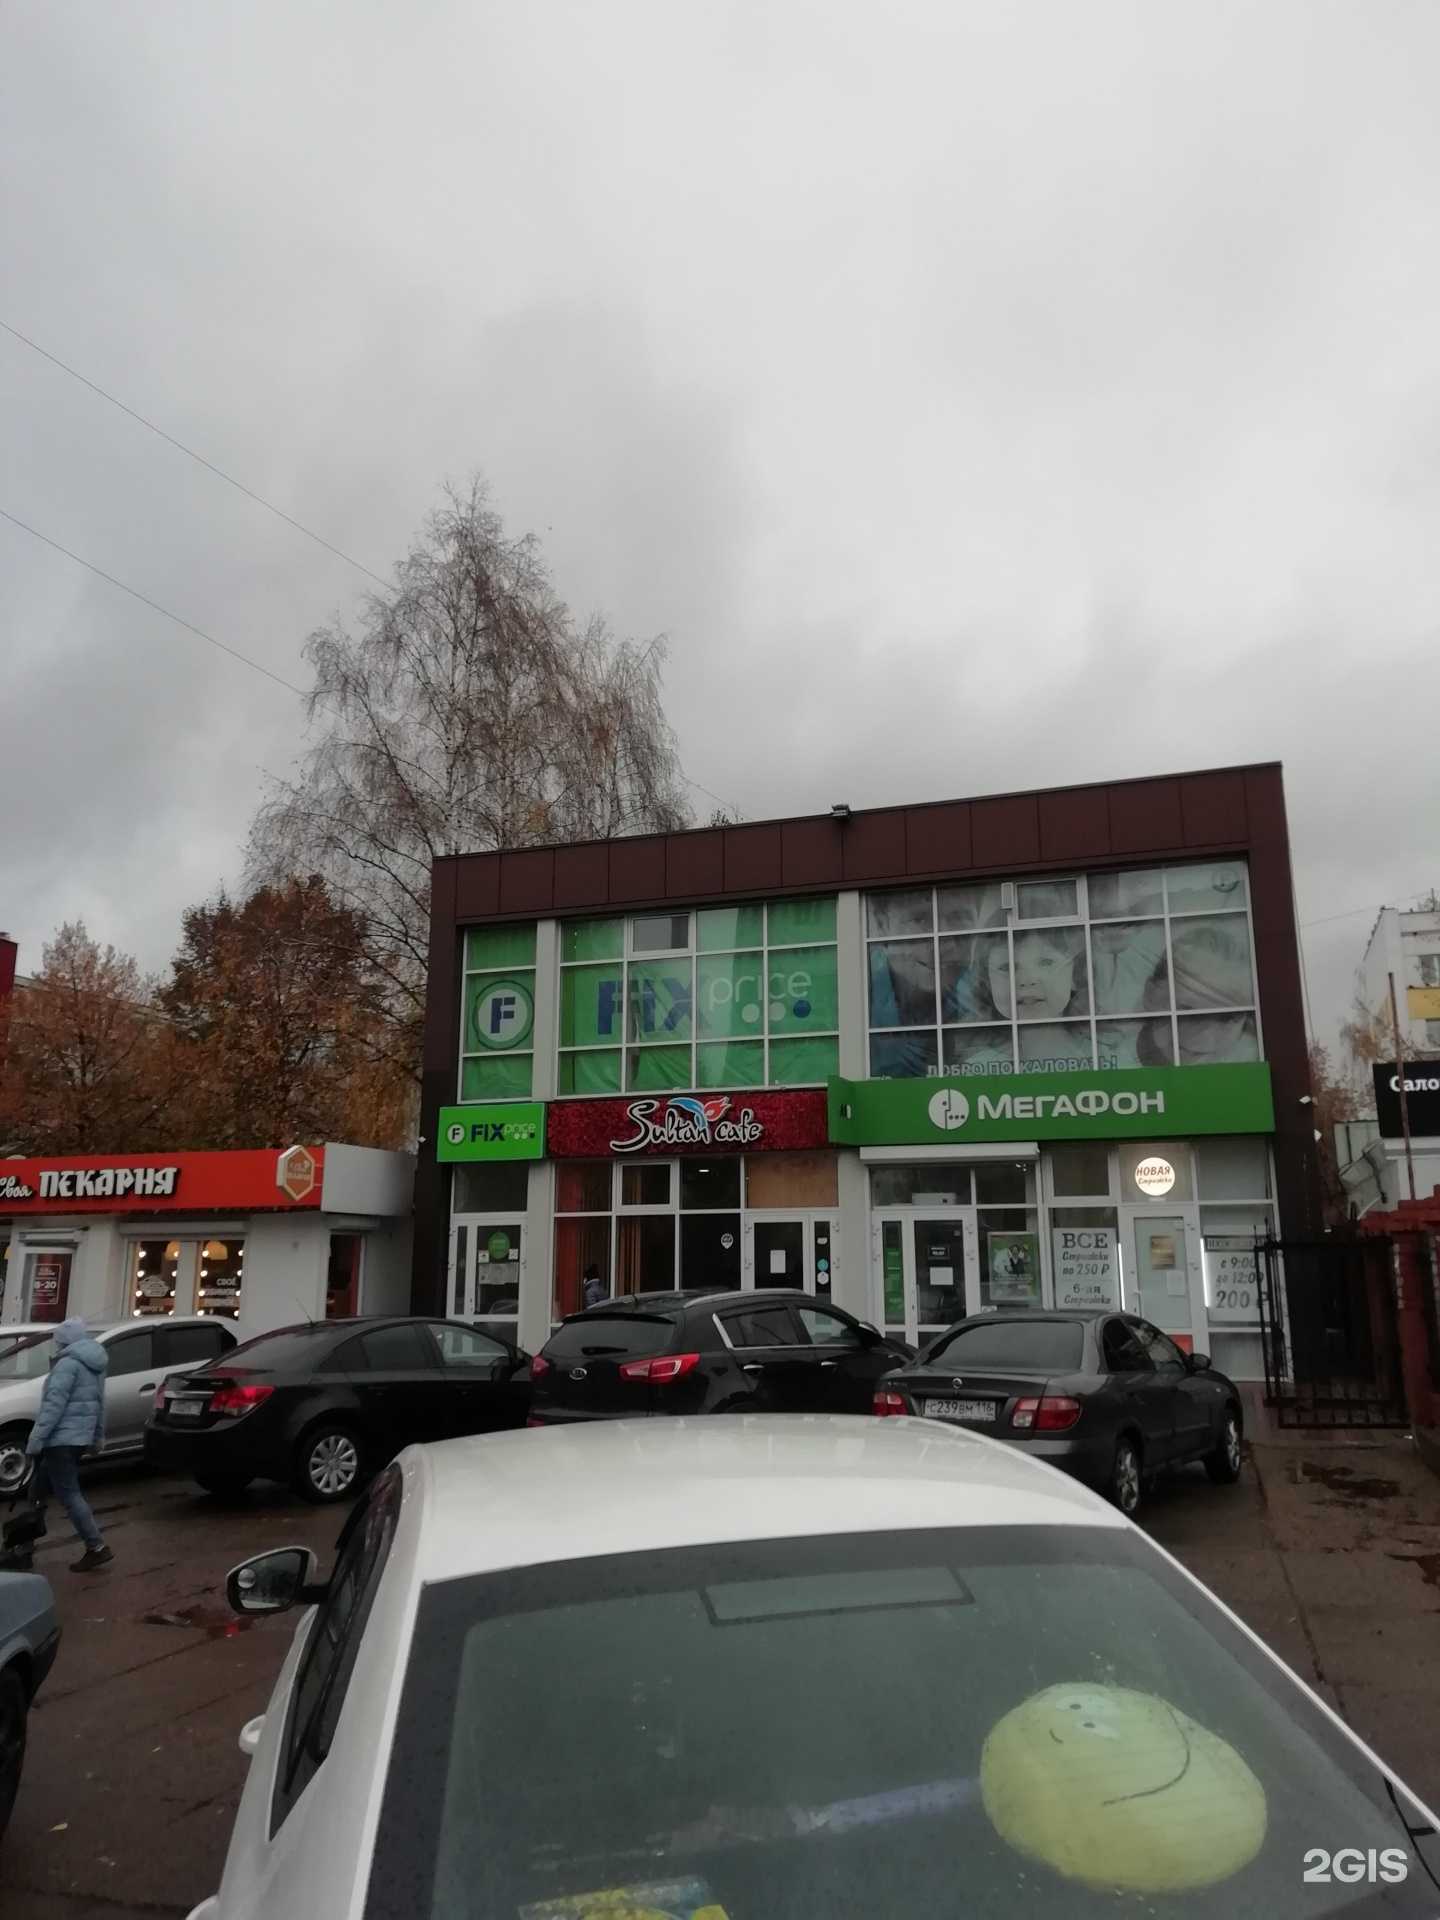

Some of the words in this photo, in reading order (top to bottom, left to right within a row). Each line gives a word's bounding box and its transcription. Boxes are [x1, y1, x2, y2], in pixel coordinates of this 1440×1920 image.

[490, 996, 516, 1034] F
[598, 976, 706, 1035] FIX
[710, 971, 812, 1010] price
[977, 1090, 1165, 1120] МЕГАФОН
[470, 1123, 506, 1142] FIX
[609, 1099, 712, 1152] Sultan
[714, 1108, 764, 1143] cafe
[39, 1167, 178, 1198] ПЕКАРНЯ
[1136, 1166, 1171, 1176] НОВАЯ
[1061, 1232, 1108, 1249] ВСЕ
[1077, 1263, 1098, 1275] 250
[1216, 1290, 1250, 1309] 200
